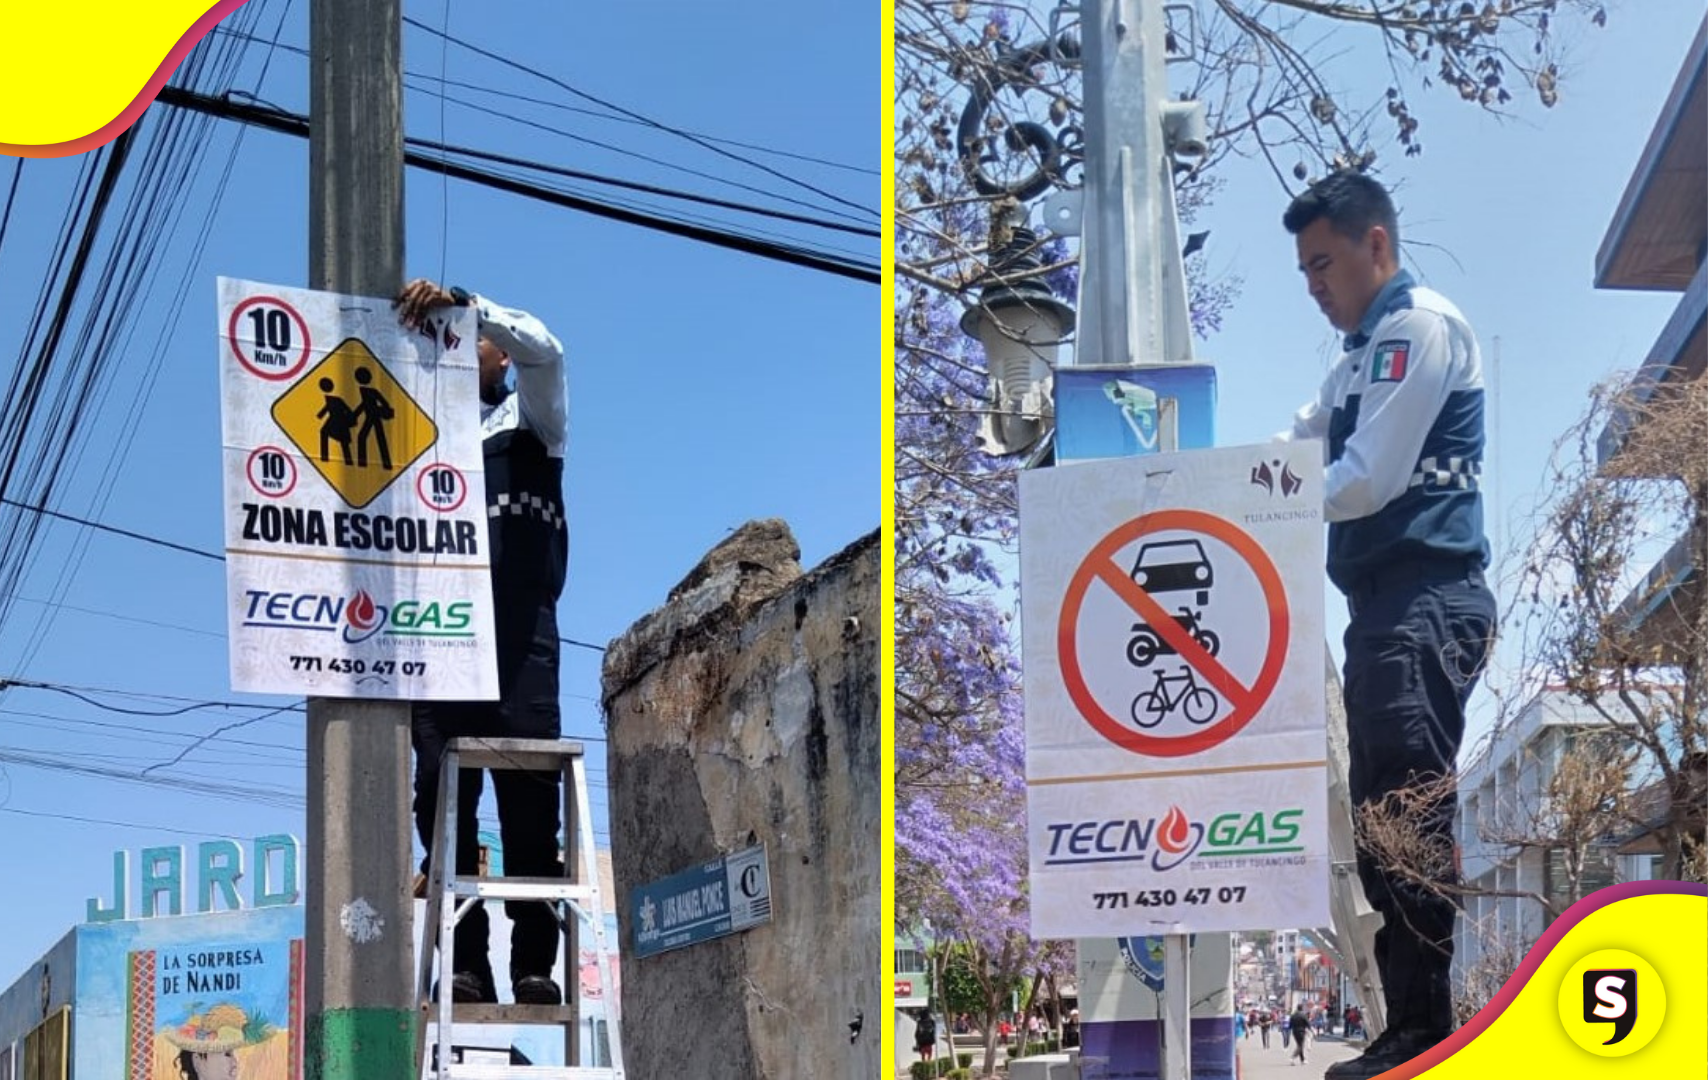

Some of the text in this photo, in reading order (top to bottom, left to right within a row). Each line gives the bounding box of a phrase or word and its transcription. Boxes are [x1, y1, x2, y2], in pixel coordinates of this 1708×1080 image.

[248, 308, 290, 351] 10
[254, 350, 287, 367] Km/h
[258, 452, 285, 480] 10
[428, 470, 455, 494] 10
[1244, 510, 1319, 524] TULANCINGO
[242, 503, 478, 555] ZONA ESCOLAR
[290, 655, 427, 676] 771 430 47 07
[1093, 886, 1247, 909] 771 430 47 07
[163, 947, 264, 971] LA SORPRESA
[163, 975, 181, 995] DE
